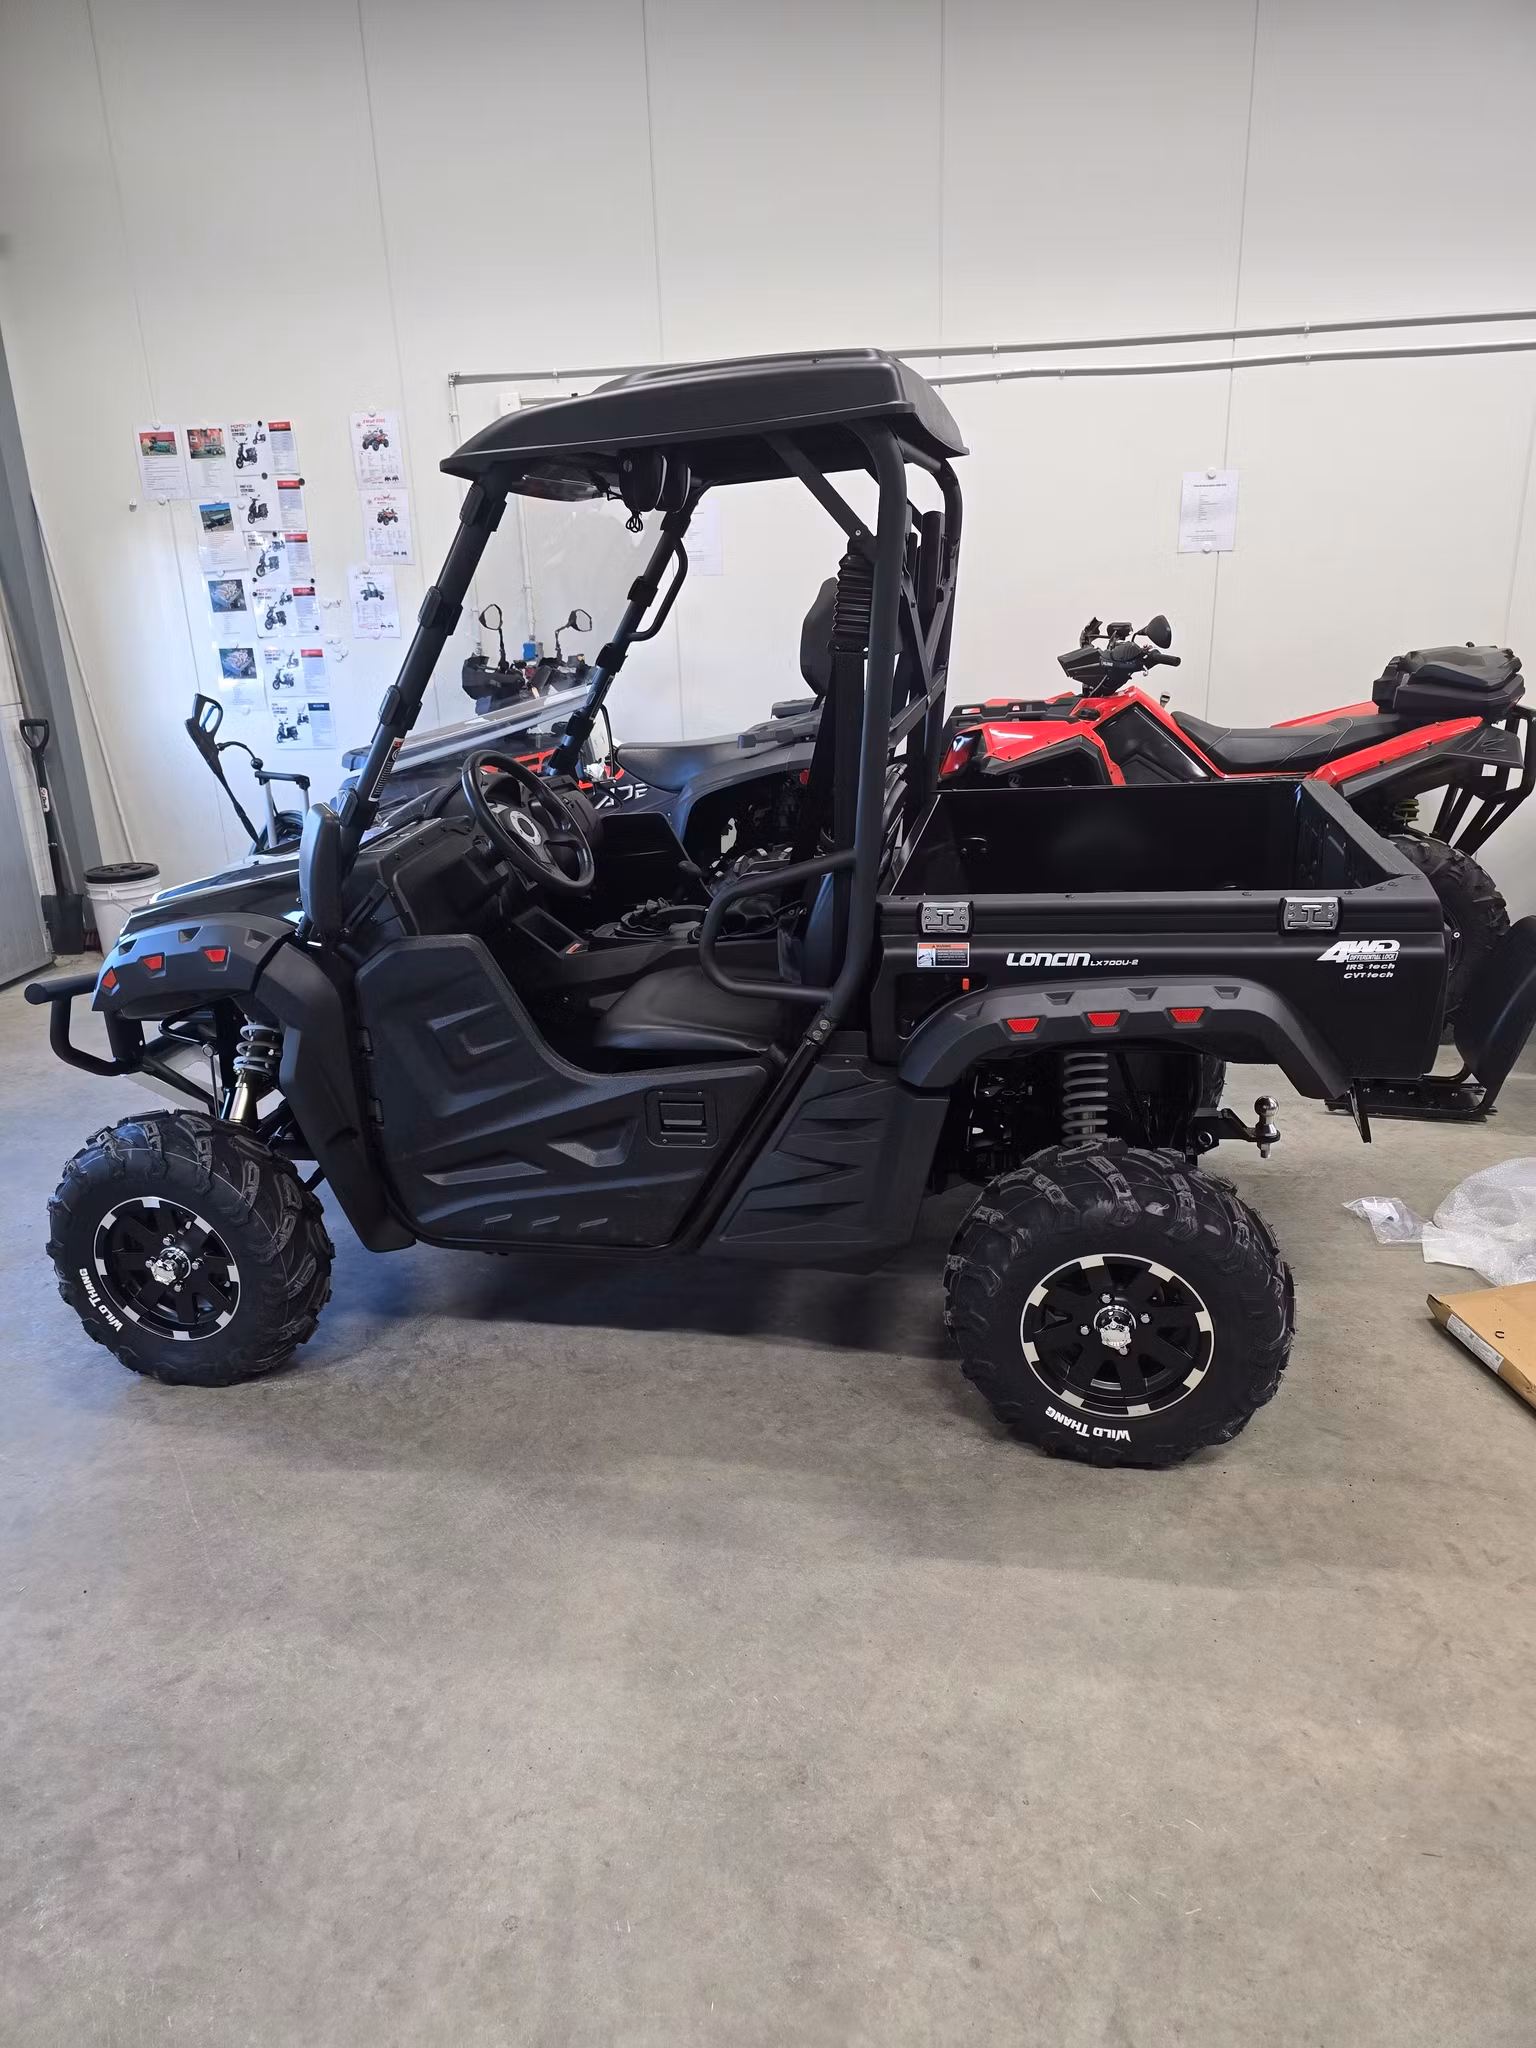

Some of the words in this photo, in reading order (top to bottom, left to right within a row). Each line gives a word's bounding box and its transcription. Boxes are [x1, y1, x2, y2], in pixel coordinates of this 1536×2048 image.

[1006, 952, 1091, 967] LONCIN
[1316, 940, 1400, 963] 4WD
[79, 1268, 102, 1307] THANG
[98, 1305, 123, 1332] WILD
[1044, 1406, 1090, 1438] THANG
[1092, 1427, 1132, 1443] WILD
